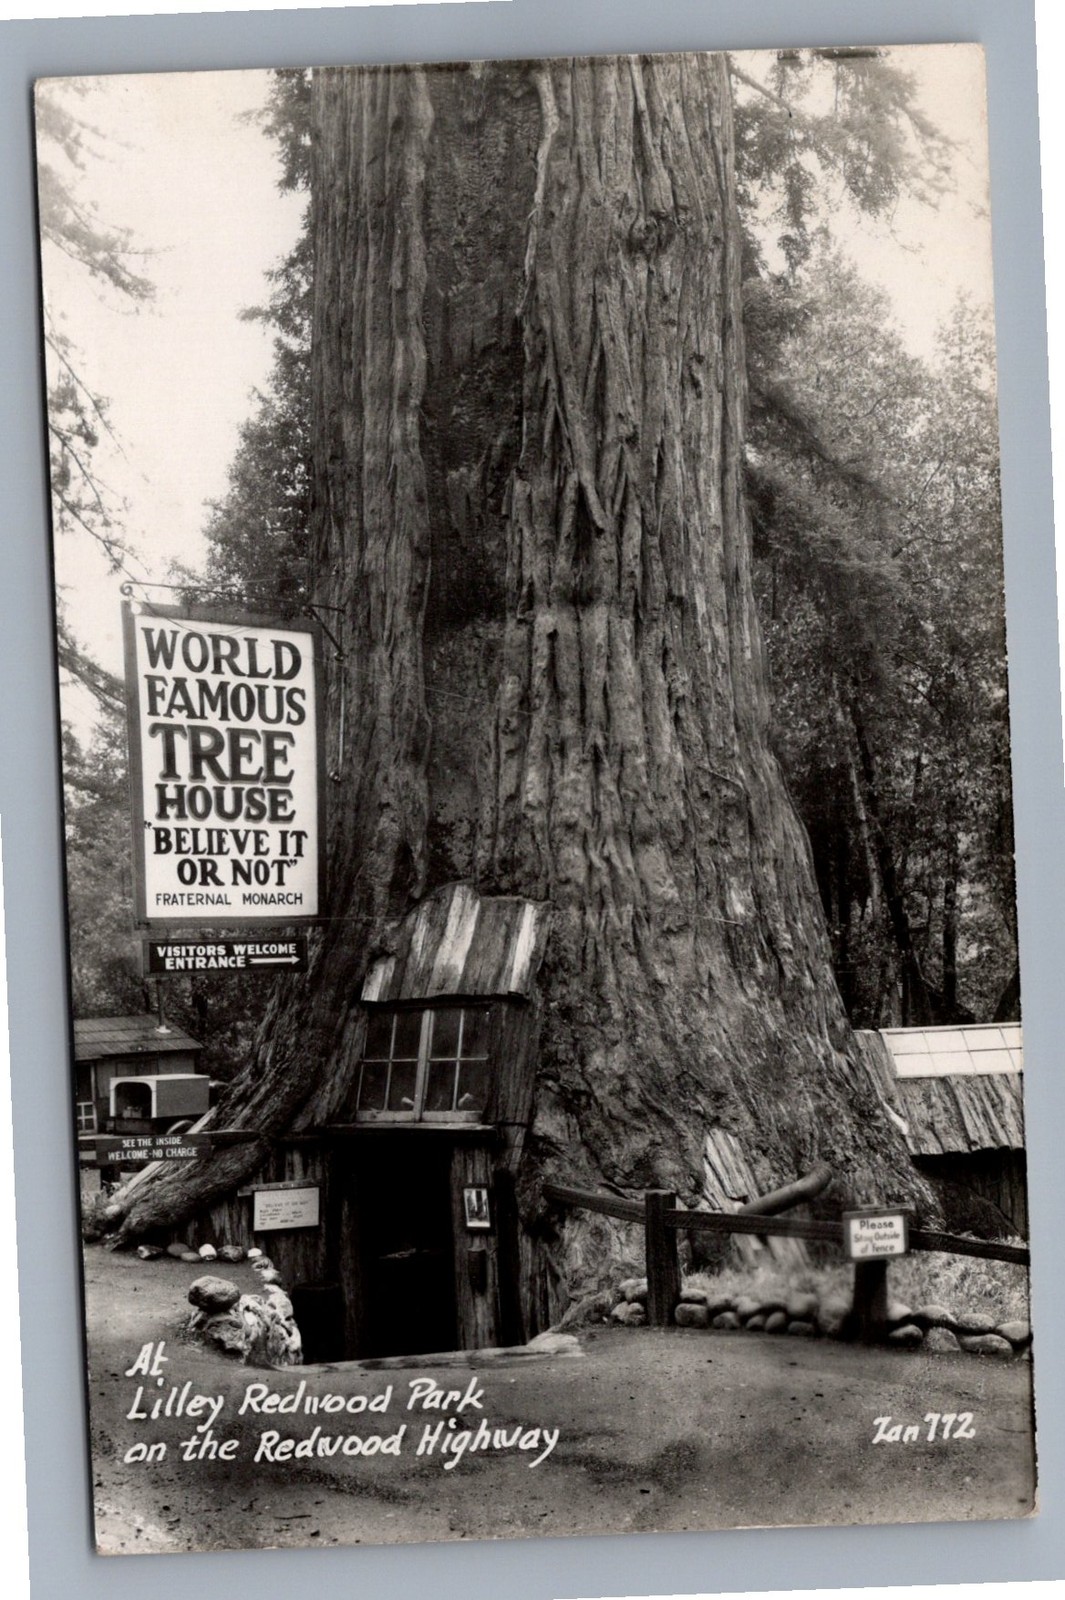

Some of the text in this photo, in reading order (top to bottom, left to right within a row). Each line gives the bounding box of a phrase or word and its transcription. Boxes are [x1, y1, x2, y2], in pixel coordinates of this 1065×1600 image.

[141, 627, 302, 681] WORLD
[144, 674, 306, 726] FAMOUS
[149, 722, 296, 787] TREE
[155, 783, 296, 825] HOUSE
[144, 820, 308, 857] "BELIEVE IT
[177, 858, 298, 887] OR NOT"
[156, 892, 303, 906] FRATERNAL MONARCH
[156, 943, 297, 957] VISITORS WELCOME
[165, 956, 246, 970] ENTRANCE
[122, 1136, 182, 1148] SEE THE INSIDE
[166, 1147, 198, 1157] CHARGE
[860, 1219, 894, 1230] Please
